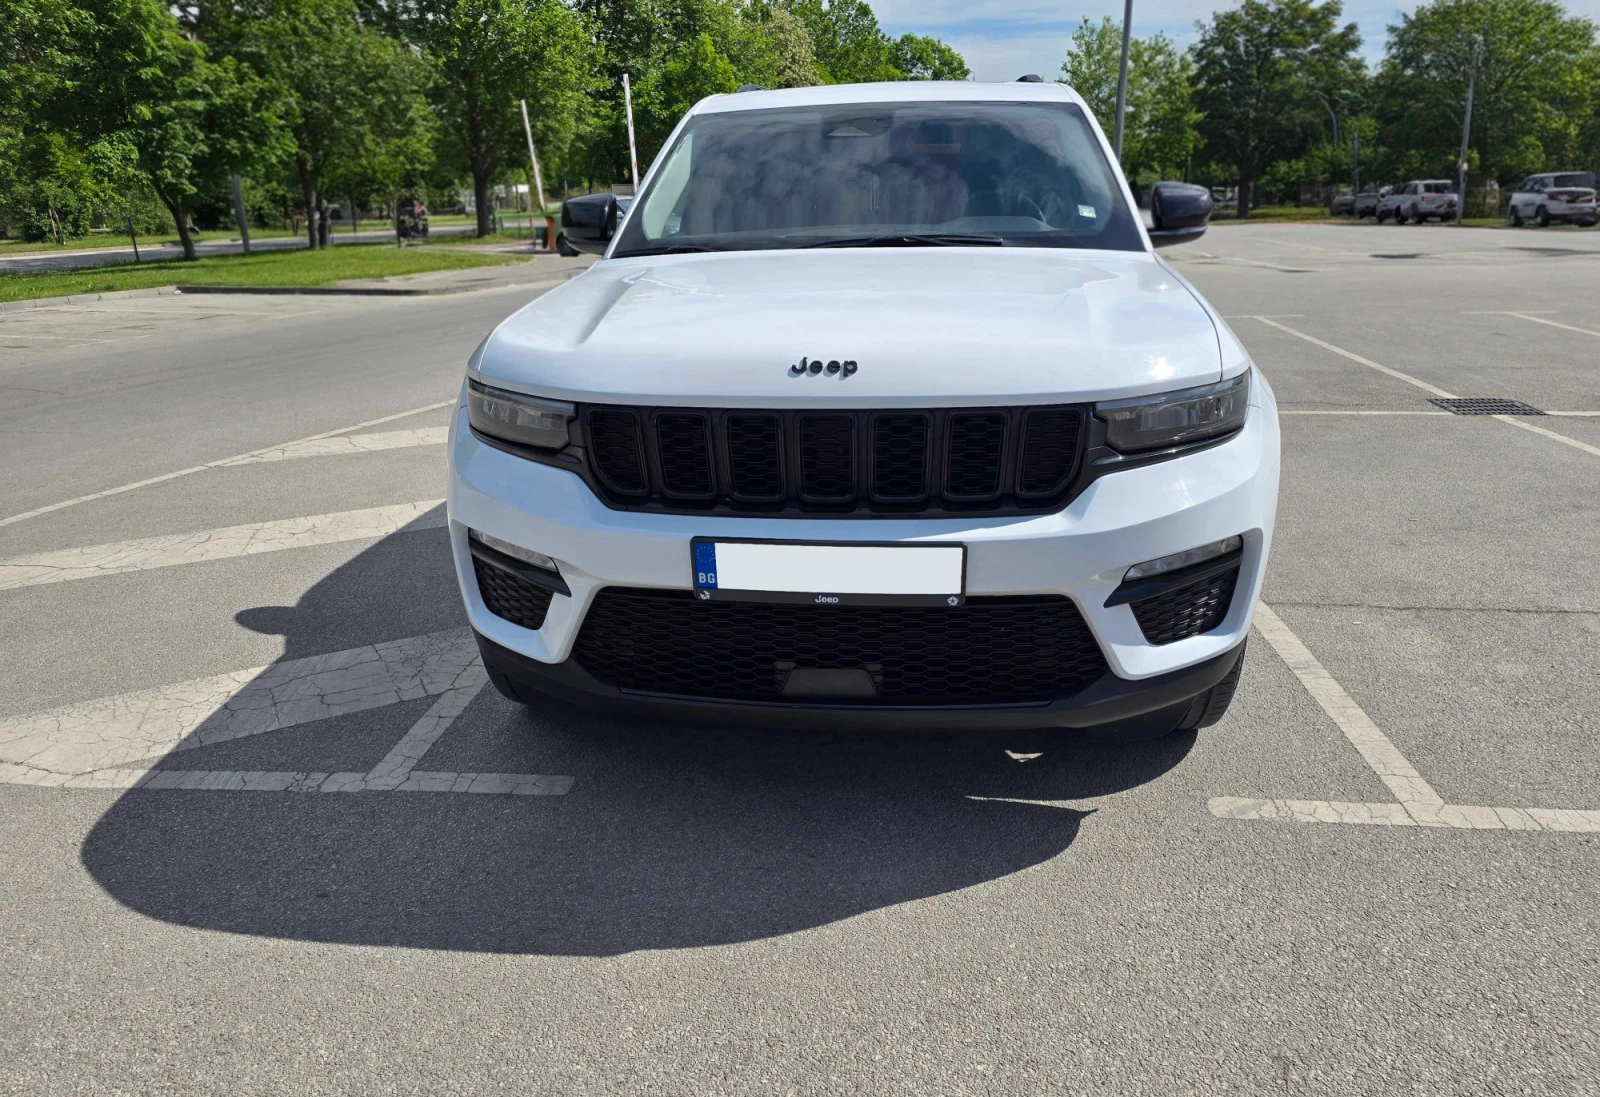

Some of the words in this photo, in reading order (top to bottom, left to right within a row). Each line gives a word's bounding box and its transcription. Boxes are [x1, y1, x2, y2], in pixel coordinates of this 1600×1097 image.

[791, 356, 858, 378] Jeep
[698, 572, 715, 584] BG
[814, 595, 839, 604] Jeep
